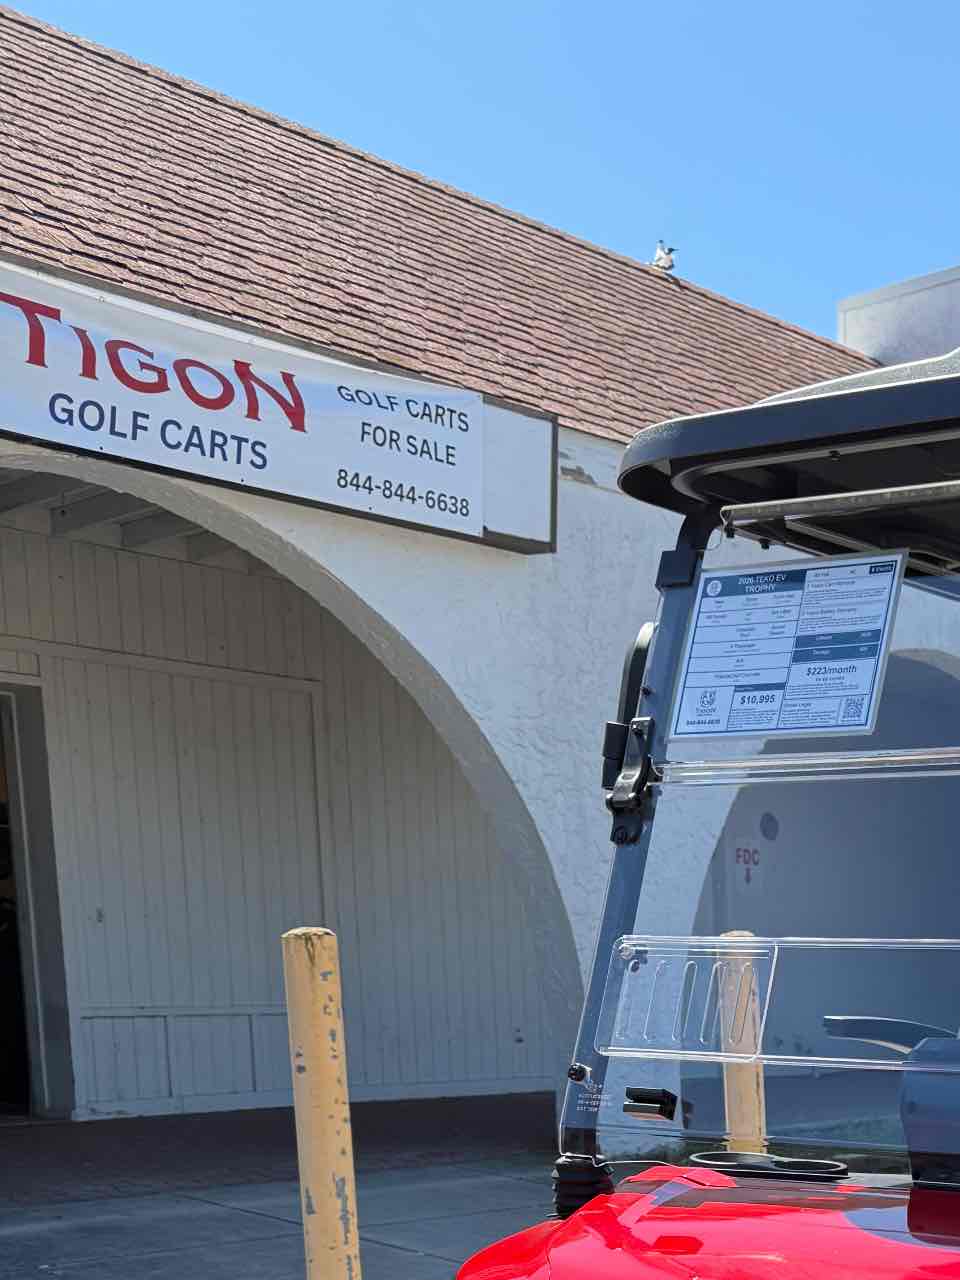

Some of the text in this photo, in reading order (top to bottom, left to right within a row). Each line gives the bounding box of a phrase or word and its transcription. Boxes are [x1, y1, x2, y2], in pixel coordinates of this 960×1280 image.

[0, 291, 306, 432] TIGON
[49, 392, 268, 470] GOLF CARTS
[337, 385, 470, 432] GOLF CARTS
[361, 422, 457, 466] FOR SALE
[337, 468, 470, 517] 844-844-6638
[807, 665, 857, 677] $223/month
[740, 694, 775, 705] $10,995
[736, 847, 760, 866] FDC
